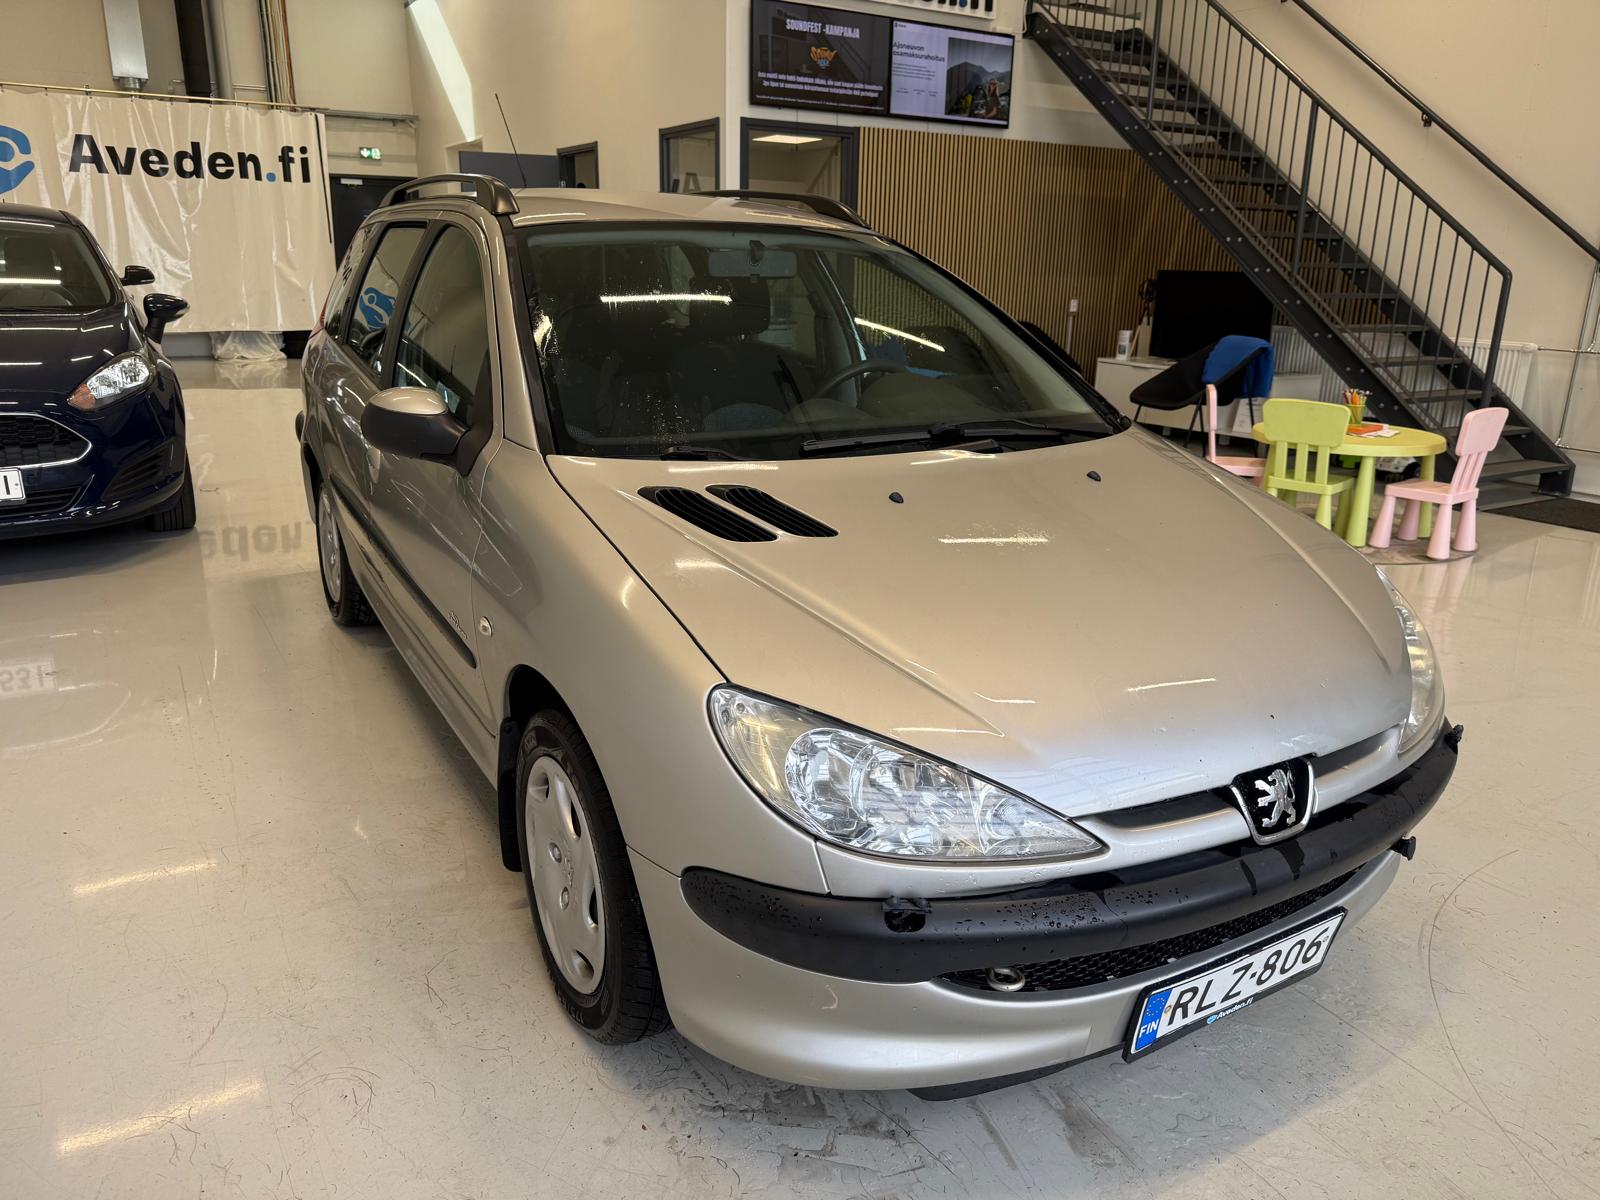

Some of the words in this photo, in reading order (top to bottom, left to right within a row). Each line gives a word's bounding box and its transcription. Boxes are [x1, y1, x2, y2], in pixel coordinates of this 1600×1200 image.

[786, 19, 822, 34] SOUNDFEST
[892, 41, 925, 52] Ajoneuvon
[69, 134, 310, 183] Aveden.fi
[1168, 927, 1329, 1028] RLZ-806
[1217, 996, 1254, 1020] Aveden.fi
[1139, 1020, 1159, 1039] FIN
